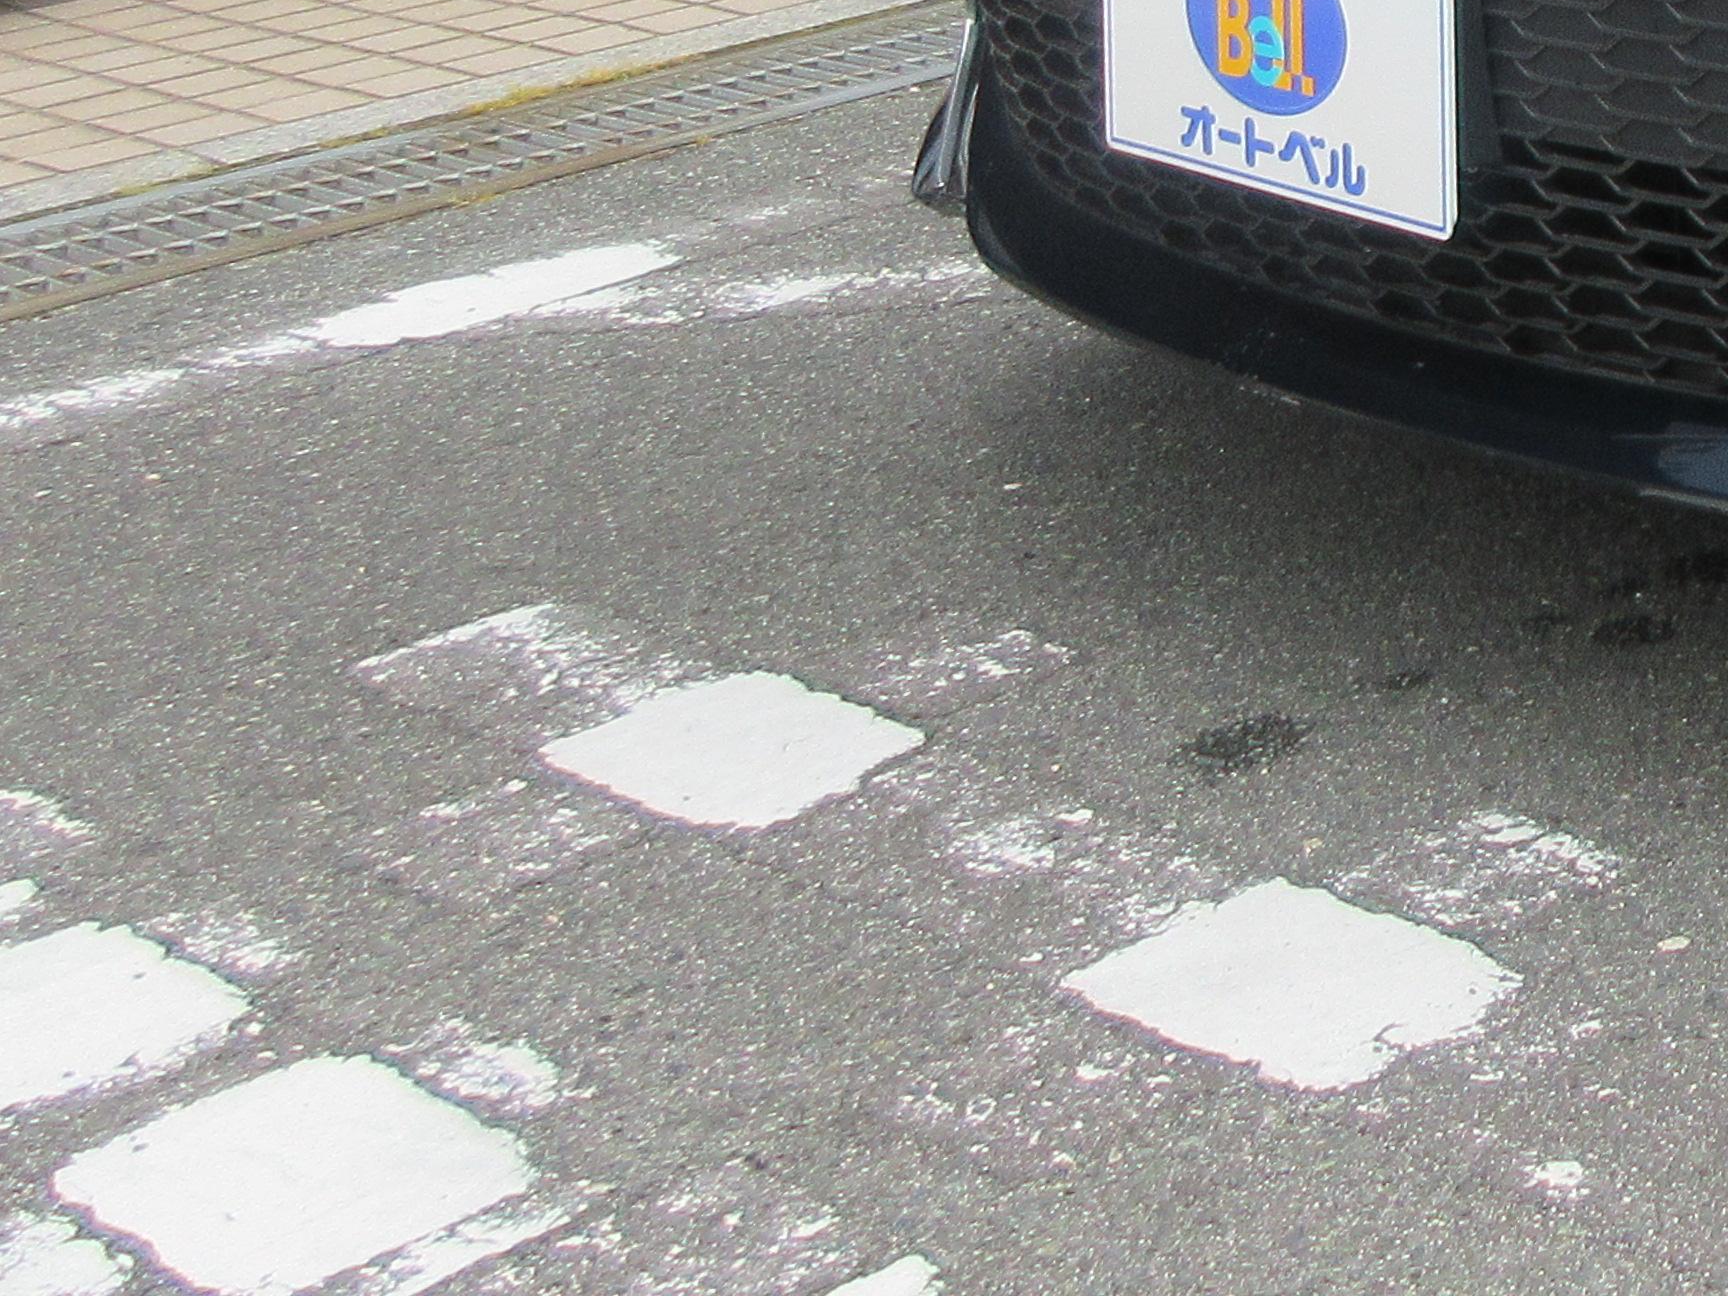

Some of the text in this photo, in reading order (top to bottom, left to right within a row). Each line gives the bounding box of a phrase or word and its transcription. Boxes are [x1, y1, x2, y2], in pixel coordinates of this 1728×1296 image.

[1179, 105, 1367, 197] オートベル
